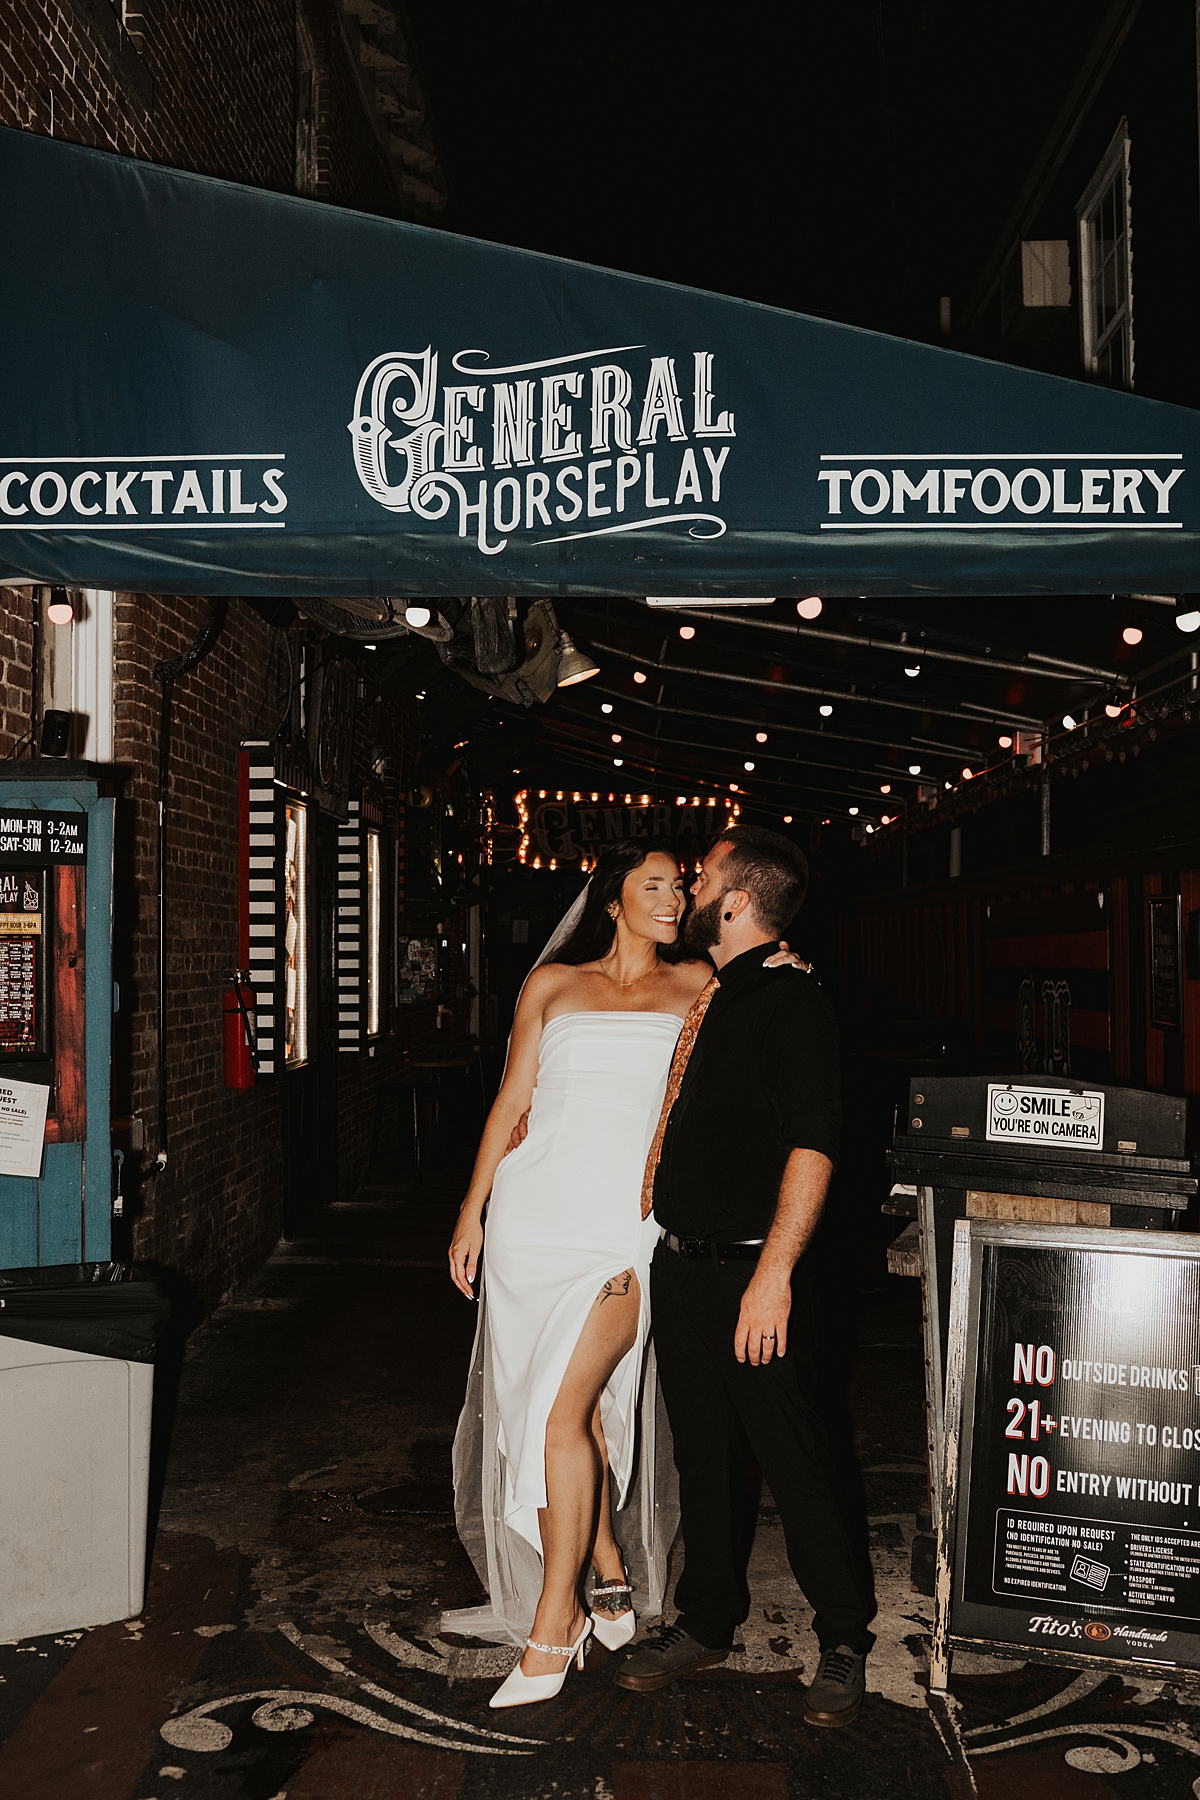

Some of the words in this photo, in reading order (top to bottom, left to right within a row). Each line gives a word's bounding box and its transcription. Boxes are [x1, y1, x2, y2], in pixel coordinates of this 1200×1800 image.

[346, 344, 736, 512] GENERAL
[0, 468, 288, 516] COCKTAILS
[410, 446, 731, 555] HORSEPLAY
[818, 468, 1185, 516] TOMFOOLERY
[0, 818, 42, 836] MON-FRI
[47, 820, 78, 836] 3-2AM
[0, 836, 42, 853] SAT-SUN
[50, 838, 84, 854] 12-2AM
[0, 876, 19, 892] AL
[1020, 1096, 1071, 1117] SMILE
[993, 1117, 1031, 1133] YOU'RE
[1033, 1120, 1049, 1135] ON
[1052, 1122, 1097, 1139] CAMERA
[1013, 1343, 1056, 1387] NO
[1062, 1359, 1128, 1387] OUTSIDE
[1130, 1365, 1189, 1391] DRINKS
[1005, 1397, 1058, 1442] 21+
[1060, 1416, 1131, 1444] EVENING
[1136, 1423, 1157, 1446] TO
[1007, 1453, 1050, 1499] NO
[1056, 1470, 1112, 1497] ENTRY
[1116, 1476, 1192, 1506] WITHOUT
[1007, 1518, 1015, 1528] ID
[1017, 1519, 1054, 1534] REQUIRED
[1057, 1524, 1078, 1537] UPON
[1080, 1527, 1116, 1541] REQUEST
[1006, 1530, 1018, 1541] (NO
[1083, 1541, 1103, 1552] SALE)
[1130, 1543, 1152, 1553] DRIVERS
[1152, 1546, 1174, 1555] LICENSE
[1131, 1533, 1140, 1541] THE
[1141, 1534, 1154, 1542] ONLY
[1164, 1537, 1190, 1547] ACCEPTED
[1129, 1559, 1145, 1568] STATE
[1145, 1561, 1185, 1573] IDENTIFICATION
[1185, 1566, 1200, 1575] CARD
[1011, 1577, 1030, 1587] EXPIRED
[1031, 1580, 1066, 1591] IDENTIFICATION
[1128, 1575, 1155, 1584] PASSPORT
[1128, 1590, 1146, 1599] ACTIVE
[1146, 1592, 1169, 1602] MILITARY
[1113, 1625, 1168, 1643] Handmade
[1126, 1639, 1154, 1649] VODKA
